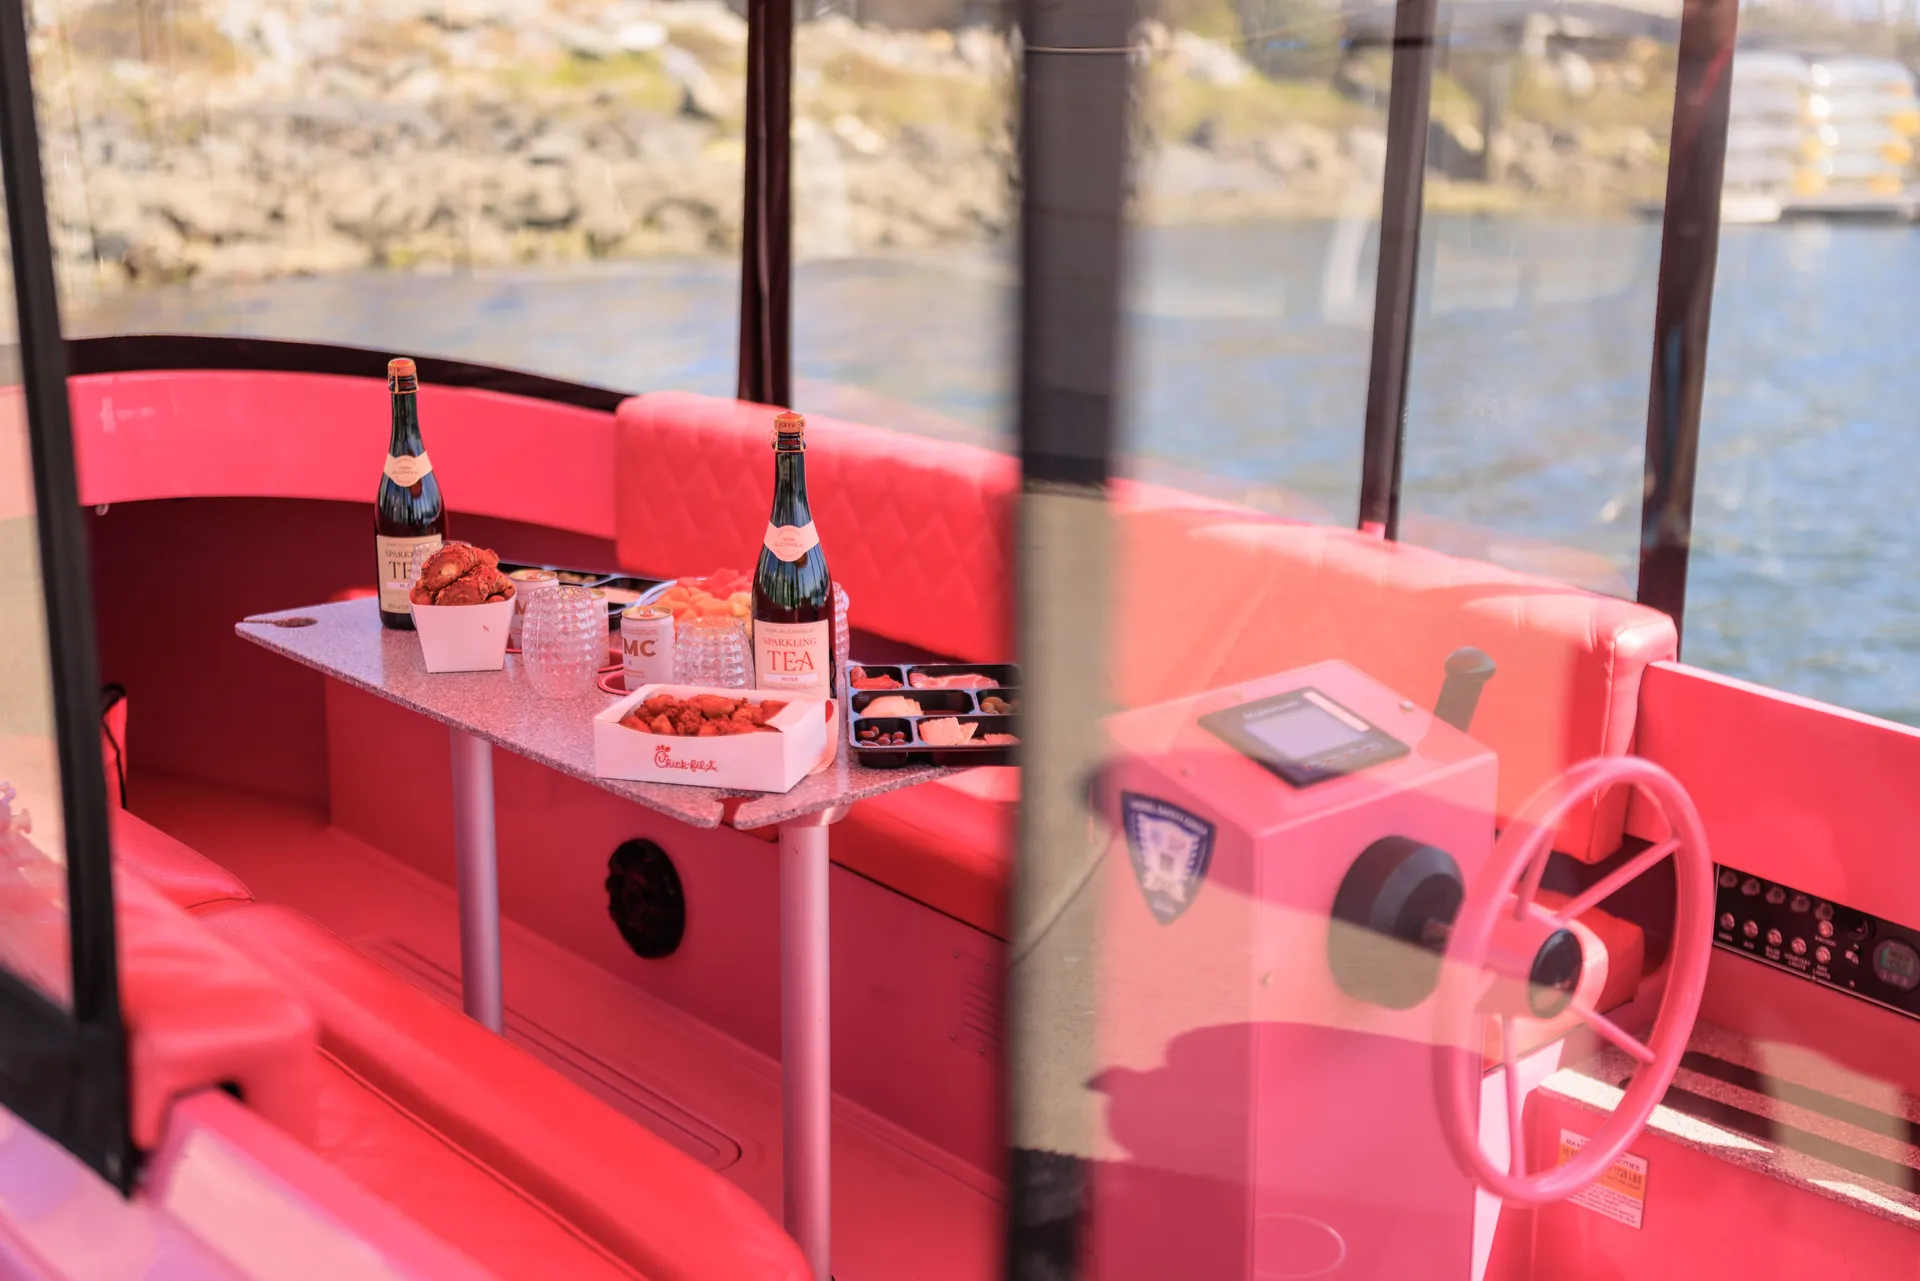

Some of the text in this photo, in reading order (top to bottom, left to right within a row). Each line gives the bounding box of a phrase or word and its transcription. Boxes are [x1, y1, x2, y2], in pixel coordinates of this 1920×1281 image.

[389, 562, 412, 579] TE
[763, 637, 817, 647] SPARKLING
[767, 650, 815, 672] TEA
